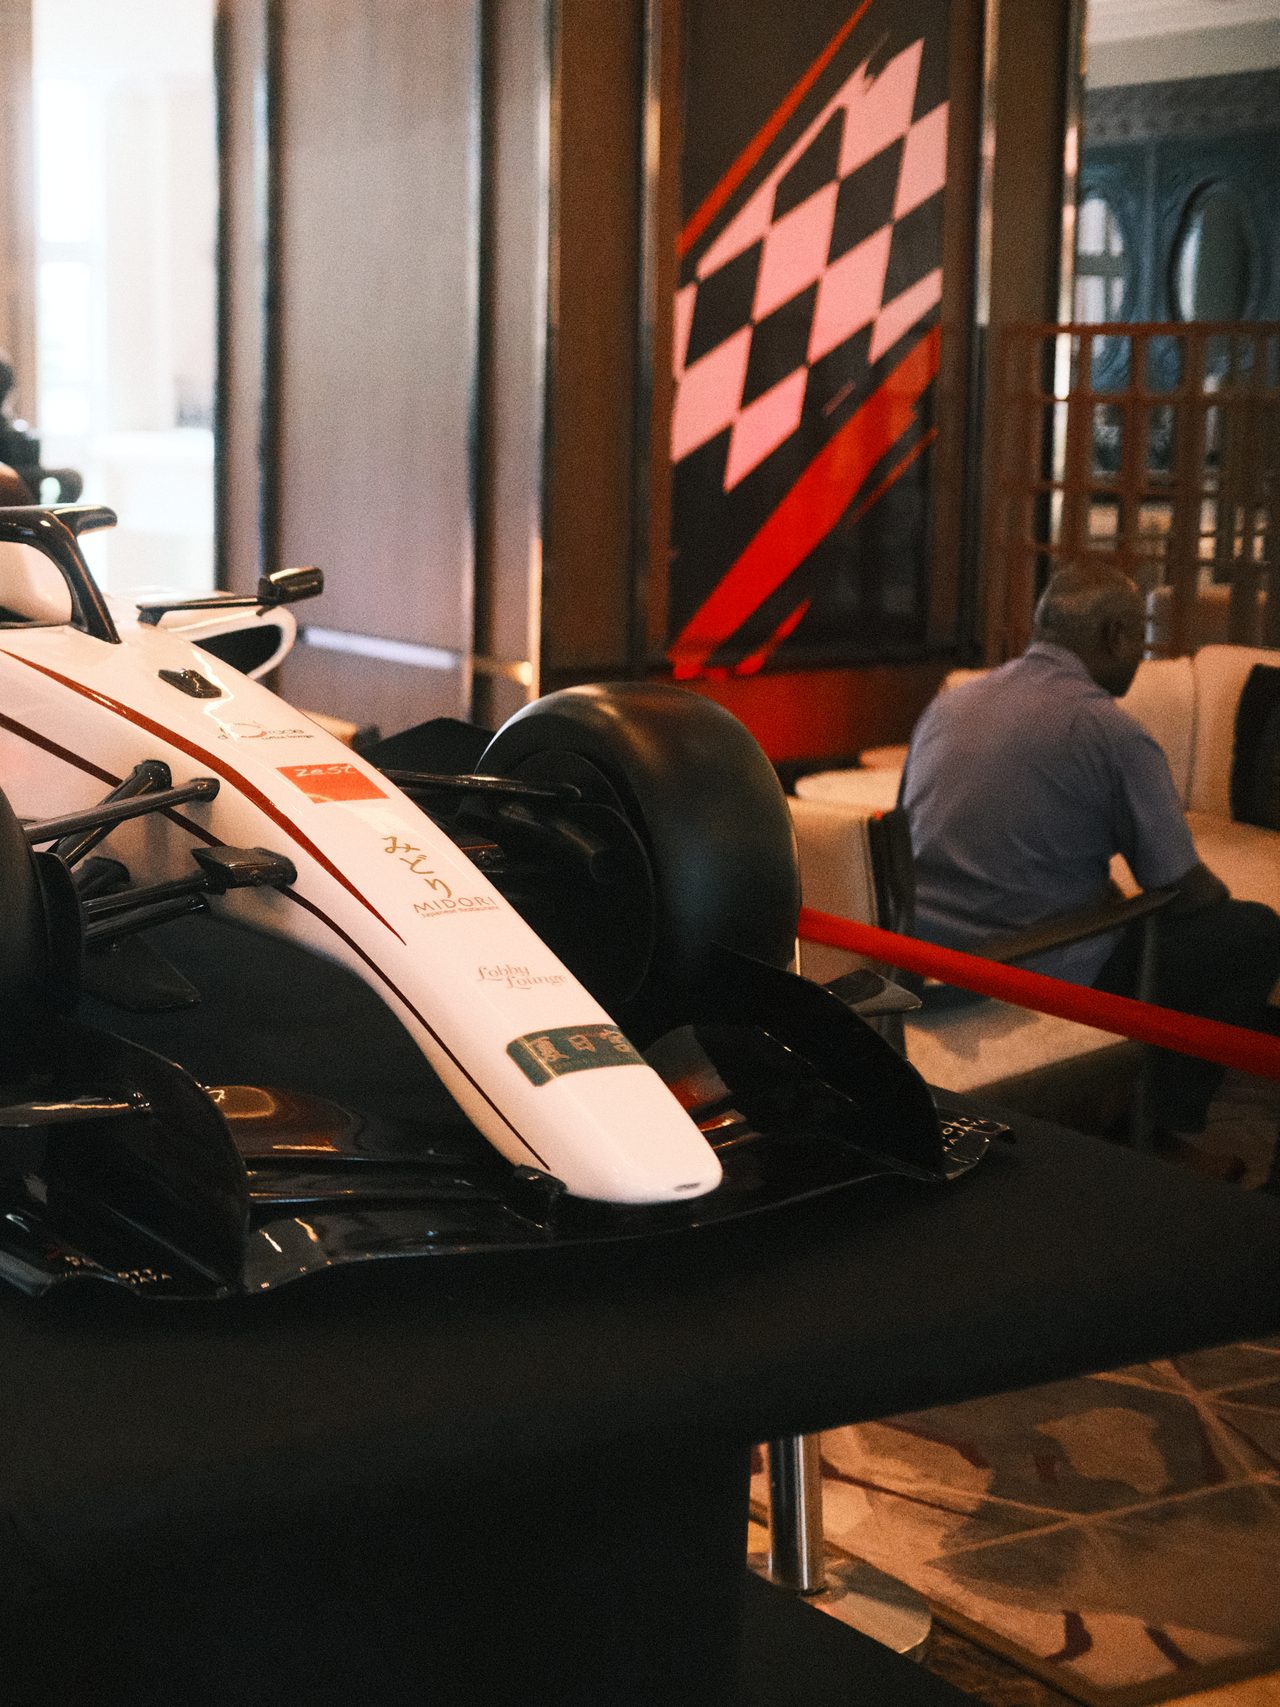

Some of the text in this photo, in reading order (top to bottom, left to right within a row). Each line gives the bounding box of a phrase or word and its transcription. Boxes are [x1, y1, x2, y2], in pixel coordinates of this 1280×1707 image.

[381, 836, 452, 898] みどり
[413, 896, 497, 914] MIDORI
[476, 964, 531, 982] Lobby
[506, 975, 567, 990] Lounge
